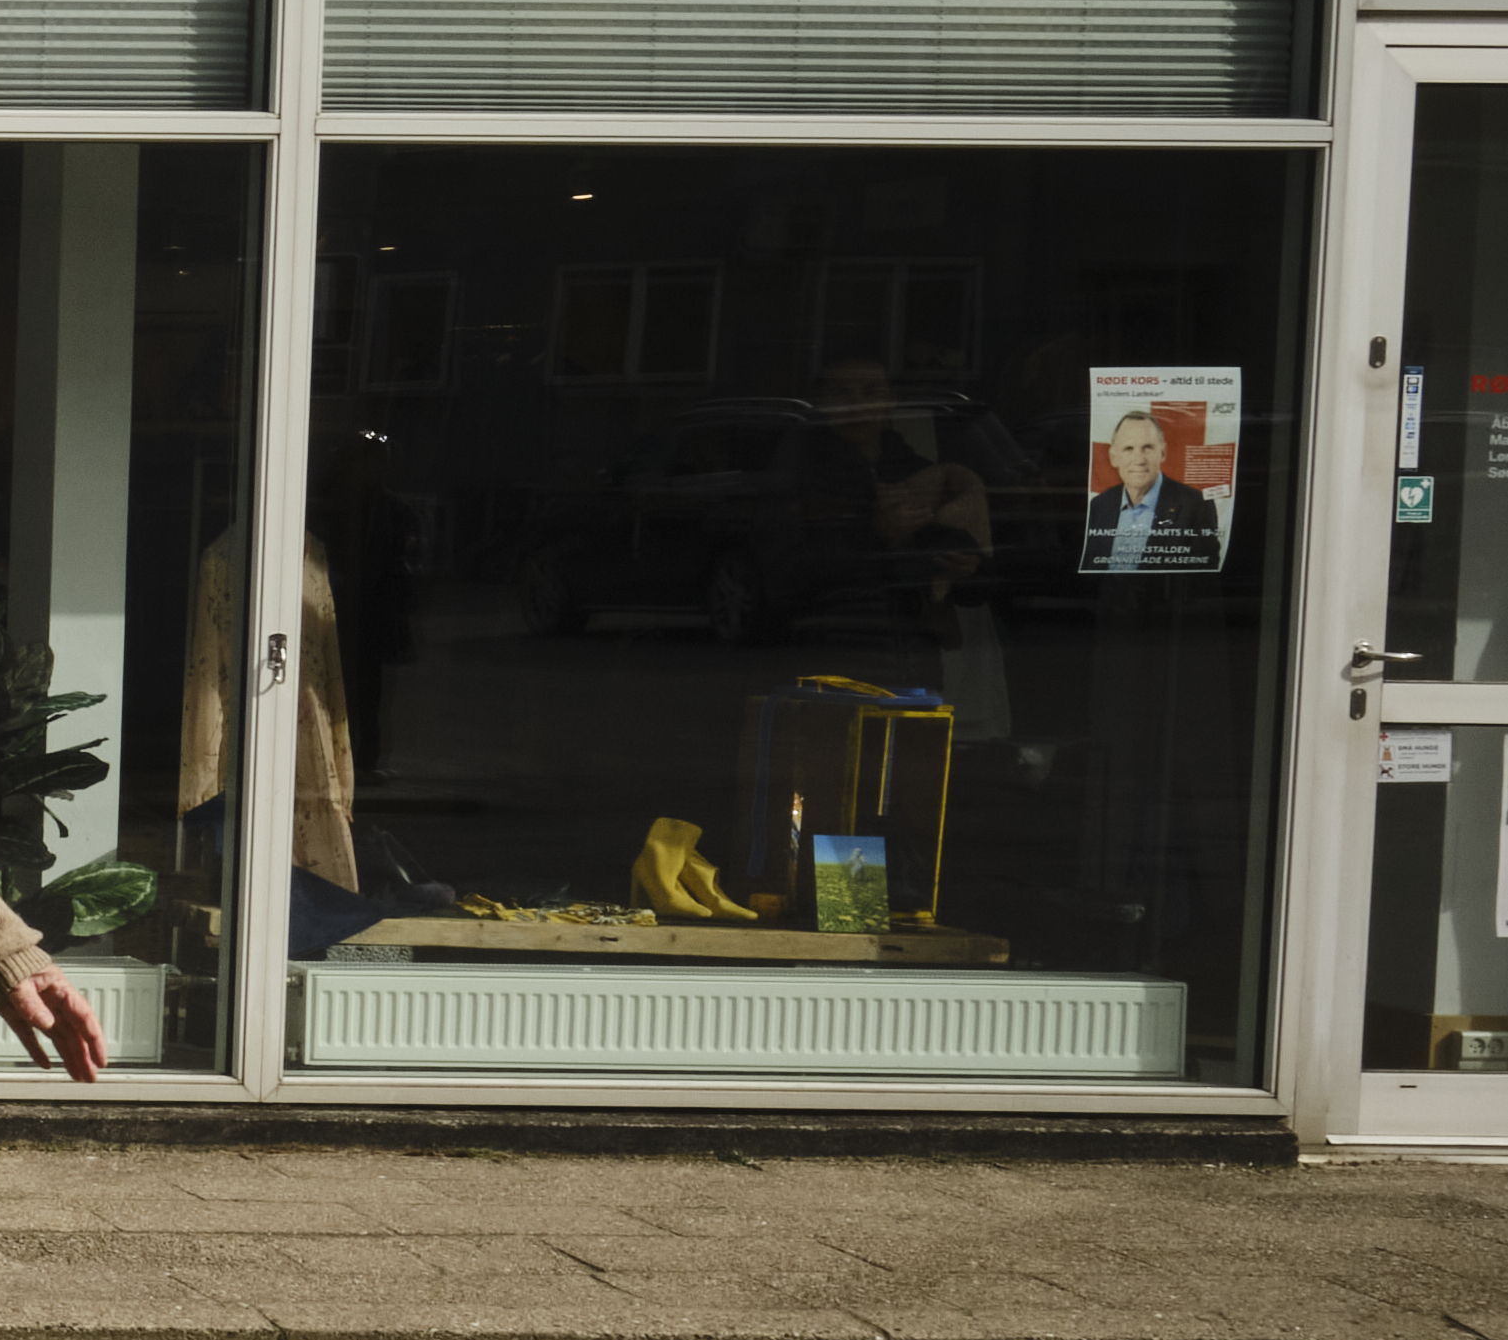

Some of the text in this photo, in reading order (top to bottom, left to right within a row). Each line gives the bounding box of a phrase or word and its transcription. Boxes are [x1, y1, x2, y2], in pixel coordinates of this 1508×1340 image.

[1096, 376, 1128, 385] RØDE
[1130, 376, 1160, 385] KORS
[1169, 376, 1193, 385] altid
[1194, 376, 1205, 385] til
[1206, 376, 1234, 385] stede
[1148, 528, 1181, 537] MARTS
[1183, 528, 1198, 537] KL.
[1164, 555, 1210, 565] KASERNE
